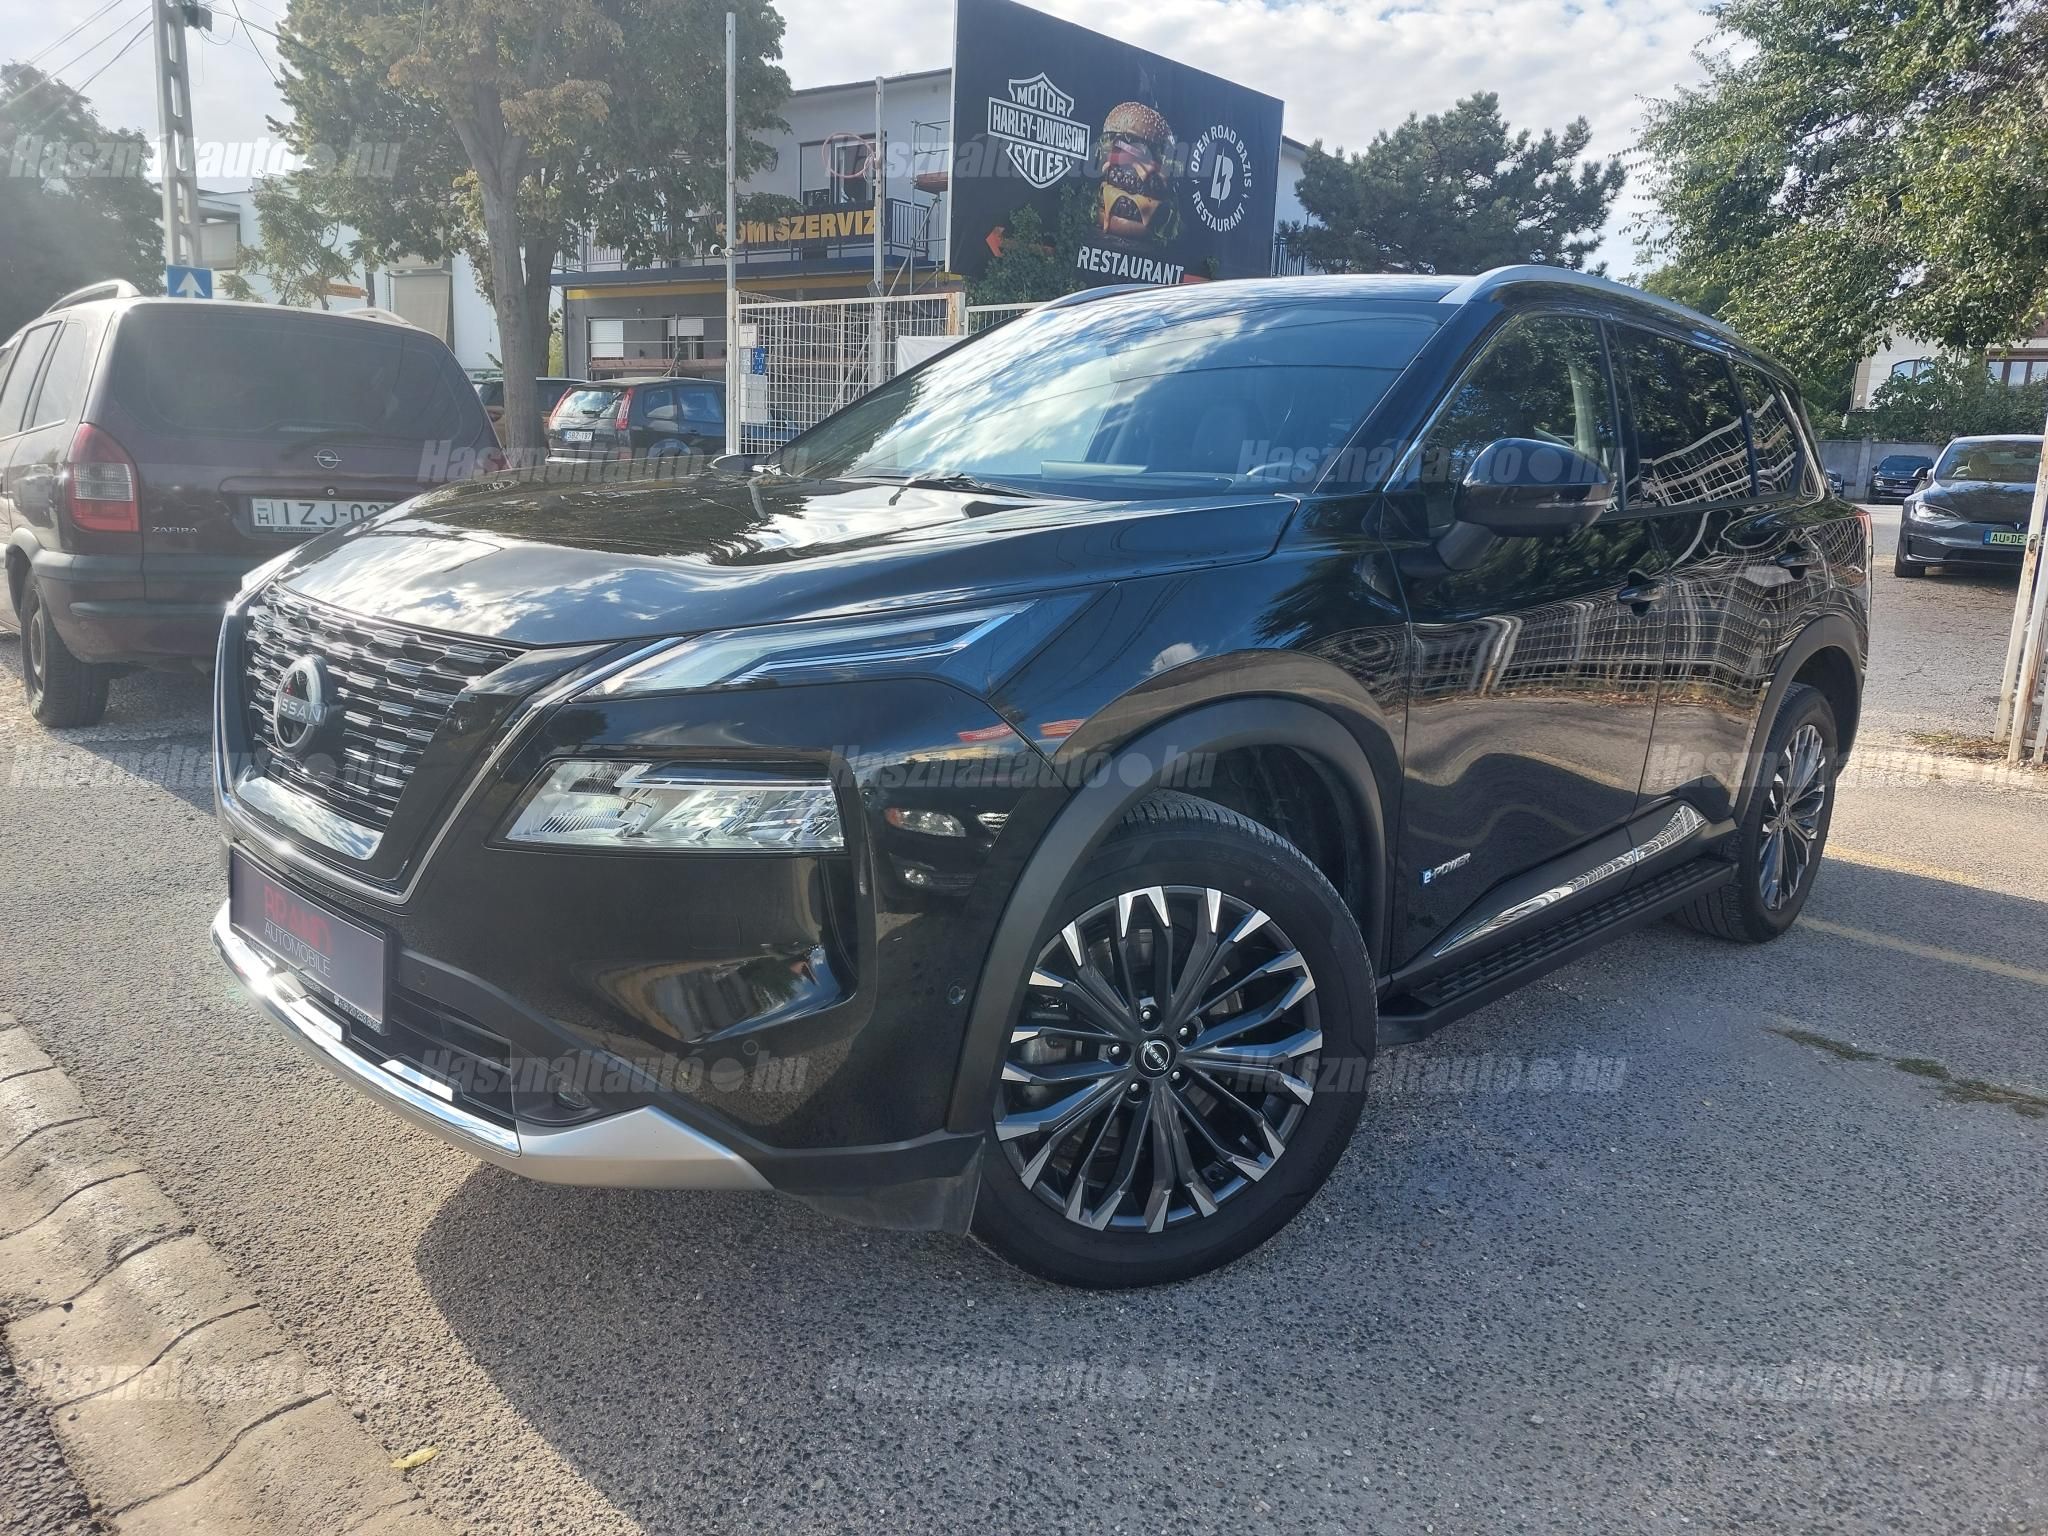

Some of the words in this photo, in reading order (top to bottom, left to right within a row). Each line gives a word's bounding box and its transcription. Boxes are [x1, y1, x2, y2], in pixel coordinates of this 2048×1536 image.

[1016, 80, 1068, 117] MOTOR
[992, 104, 1086, 154] HARLEY-DAVIDSON
[1014, 143, 1063, 183] CYCLES
[1191, 131, 1210, 172] OPEN
[1210, 124, 1237, 144] ROAD
[1235, 140, 1253, 188] BAZIS
[1192, 190, 1245, 232] RESTAURANT
[1076, 245, 1185, 286] RESTAURANT
[151, 526, 198, 534] ZAFIRA
[283, 502, 393, 526] IZJ-0
[1991, 533, 2006, 543] AU
[264, 921, 331, 978] AUTOMOBILE
